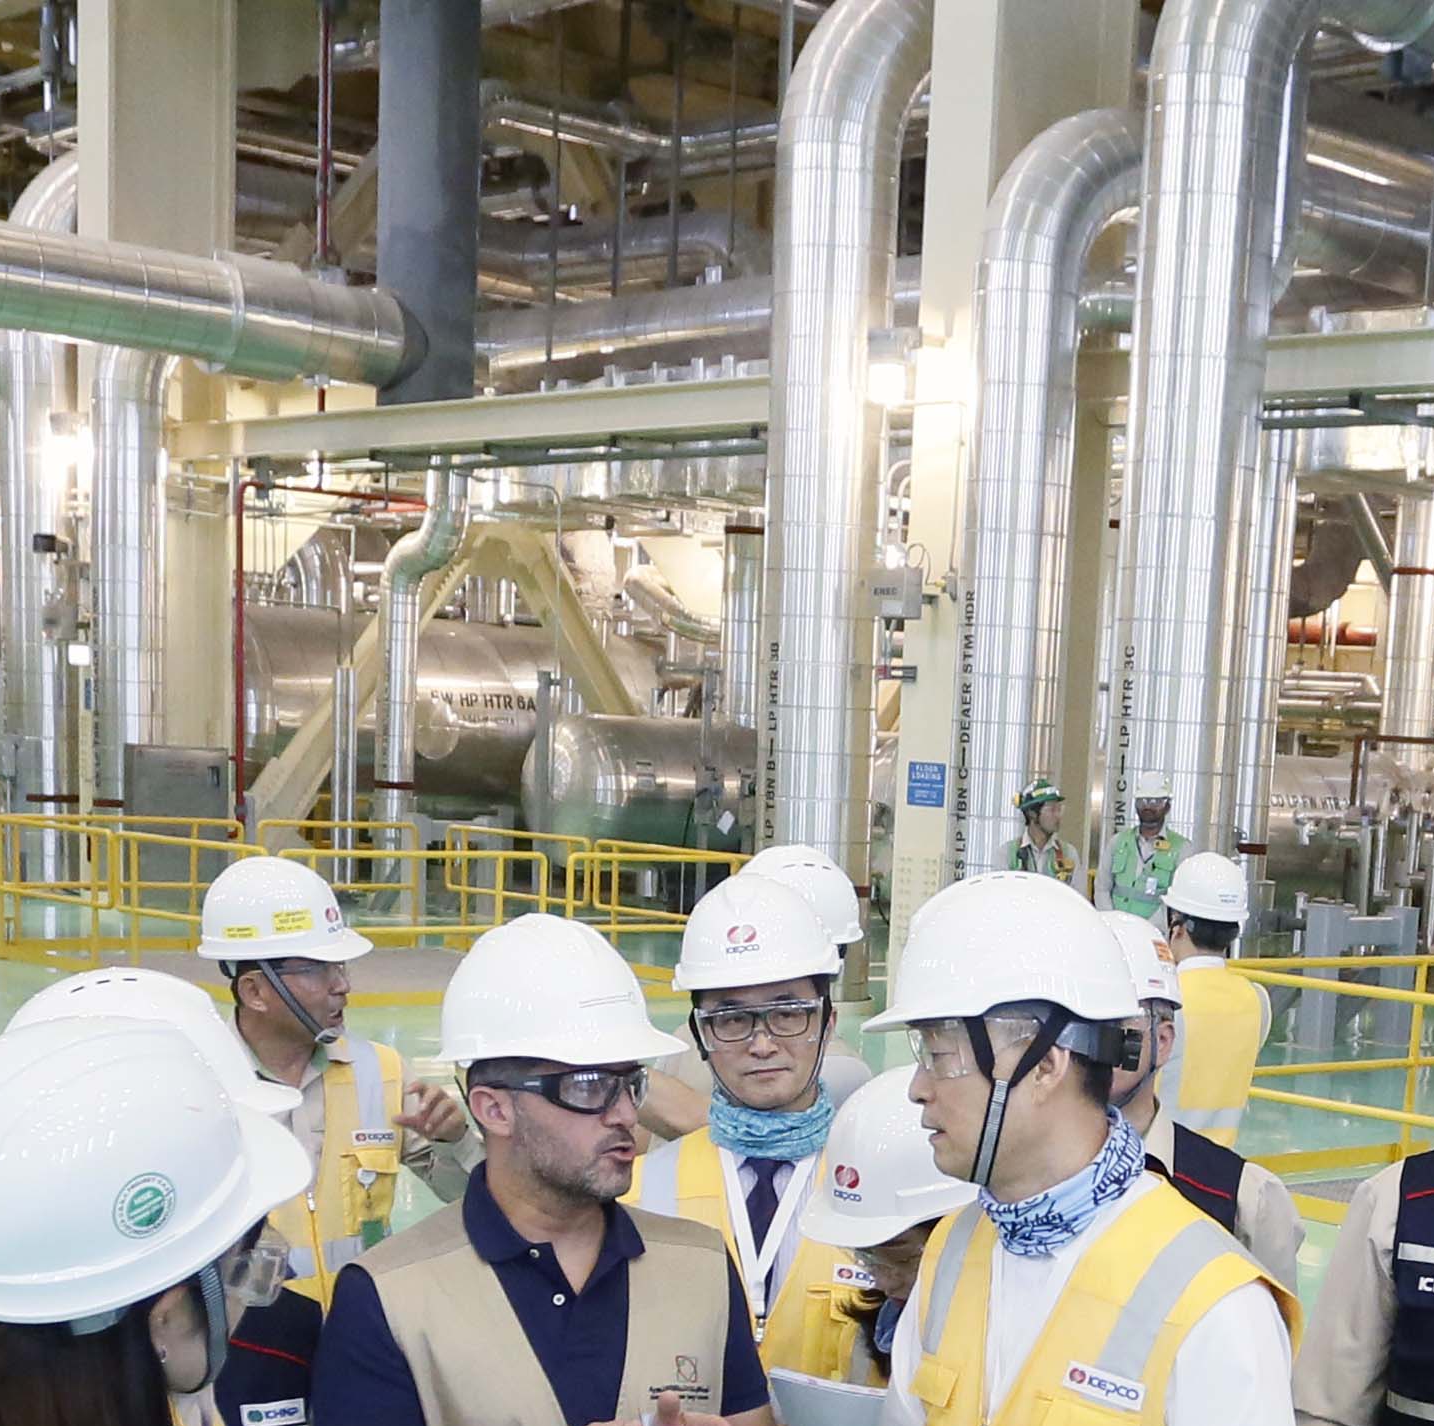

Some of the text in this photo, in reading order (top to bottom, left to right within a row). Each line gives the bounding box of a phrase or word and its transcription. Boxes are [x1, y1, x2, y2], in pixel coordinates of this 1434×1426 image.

[963, 590, 975, 627] HDR
[961, 634, 974, 674] STM
[1123, 645, 1136, 671] 3C
[767, 669, 779, 705] HTR
[1120, 678, 1134, 717] HTR
[458, 692, 479, 708] HP
[482, 693, 514, 710] HTR
[959, 682, 972, 744] DEAER
[766, 710, 778, 731] LP
[1118, 725, 1131, 748] LP
[765, 760, 776, 772] B
[957, 768, 969, 780] C
[764, 776, 776, 812] TBN
[1116, 779, 1127, 793] C
[956, 788, 968, 822] TBN
[764, 818, 775, 840] LP
[955, 831, 966, 853] LP
[1087, 1376, 1139, 1401] KEPCO
